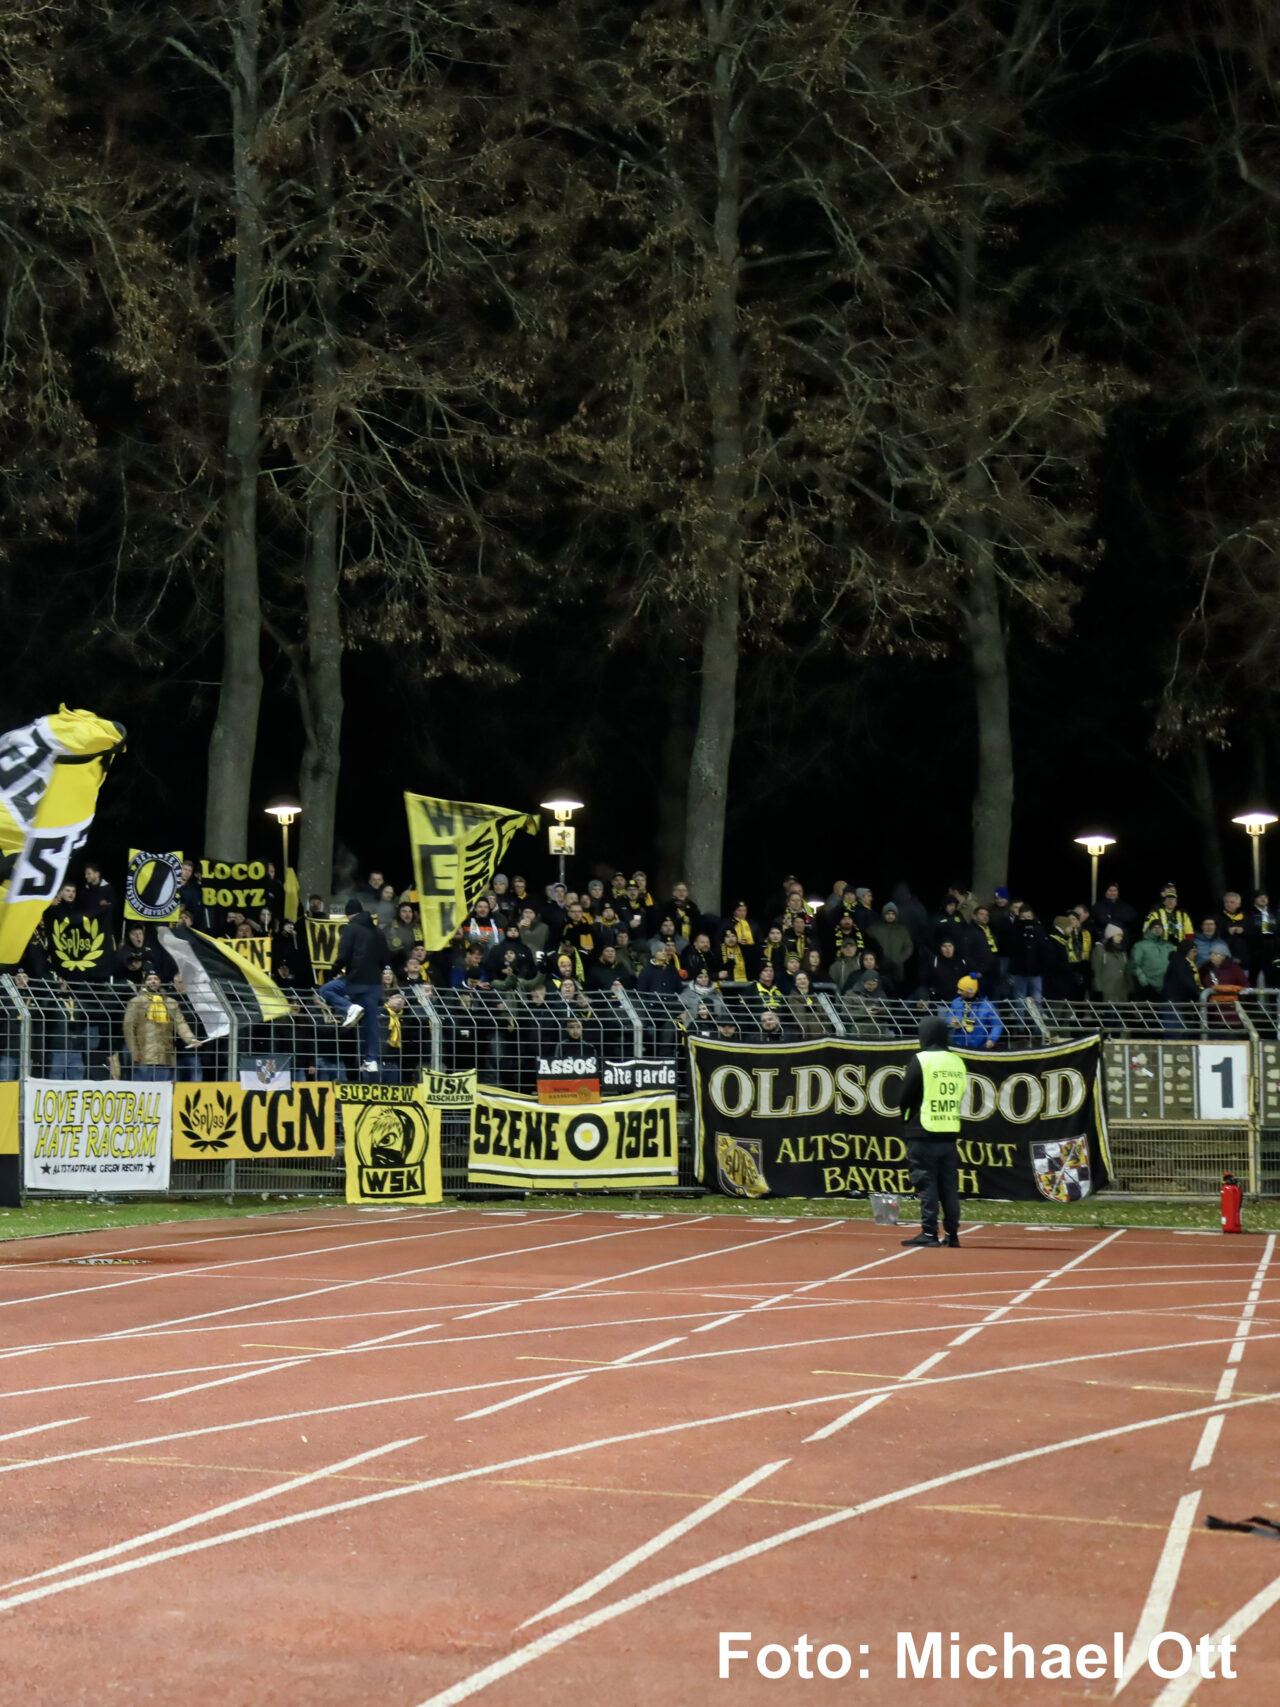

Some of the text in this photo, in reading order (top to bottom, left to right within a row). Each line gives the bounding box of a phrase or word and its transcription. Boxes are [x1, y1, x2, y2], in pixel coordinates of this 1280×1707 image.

[200, 859, 266, 881] LOCO
[201, 887, 266, 908] BOYZ
[430, 1076, 470, 1095] USK
[604, 1065, 676, 1088] alte garde
[1211, 1056, 1234, 1109] 1
[340, 1085, 415, 1101] SUPCREW
[33, 1090, 161, 1124] LOVE FOOTBALL
[242, 1087, 329, 1152] CGN
[34, 1124, 159, 1158] HATE RACISM
[473, 1104, 672, 1160] SZENE 1921
[776, 1133, 908, 1163] ALTSTAD
[100, 1165, 119, 1173] GEGEN
[365, 1168, 420, 1192] WSK
